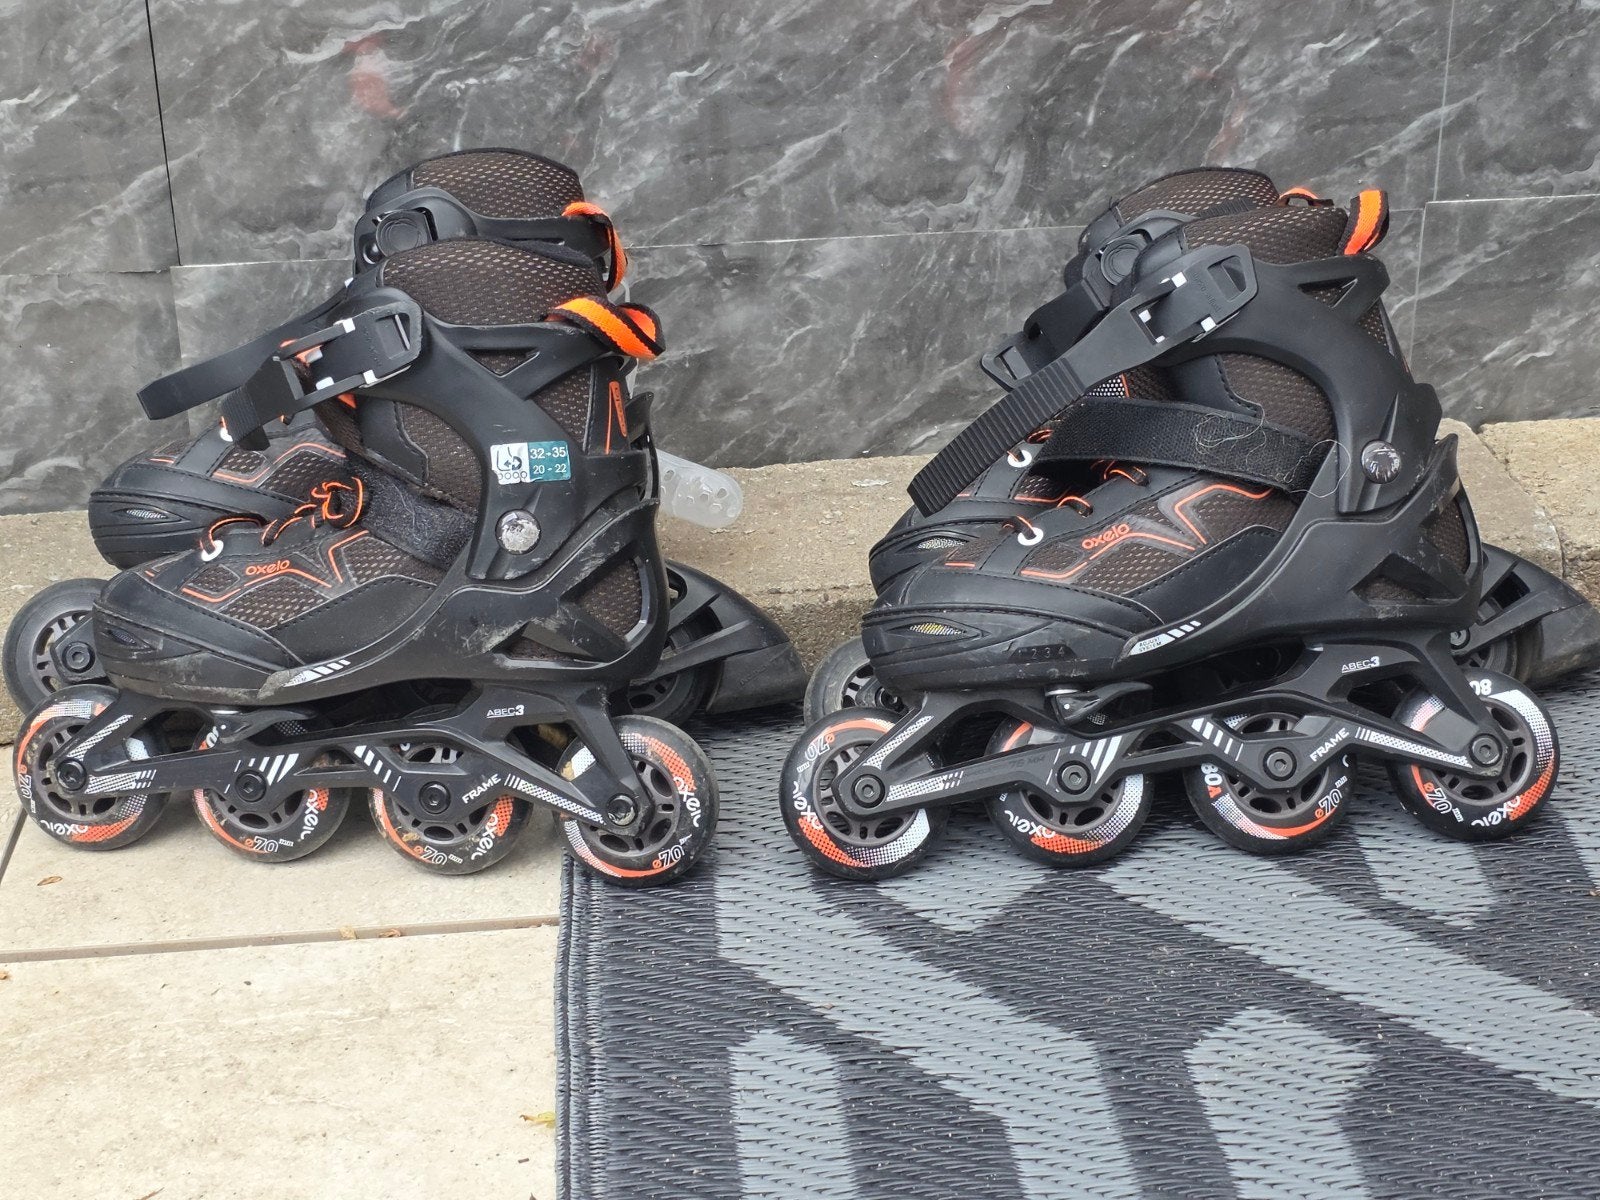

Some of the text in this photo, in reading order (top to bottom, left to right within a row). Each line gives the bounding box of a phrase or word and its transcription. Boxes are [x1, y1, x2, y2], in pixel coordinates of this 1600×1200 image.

[1081, 523, 1131, 550] oxelo
[244, 559, 290, 576] oxelo
[1309, 727, 1350, 762] FRAME
[461, 773, 502, 804] FRAME
